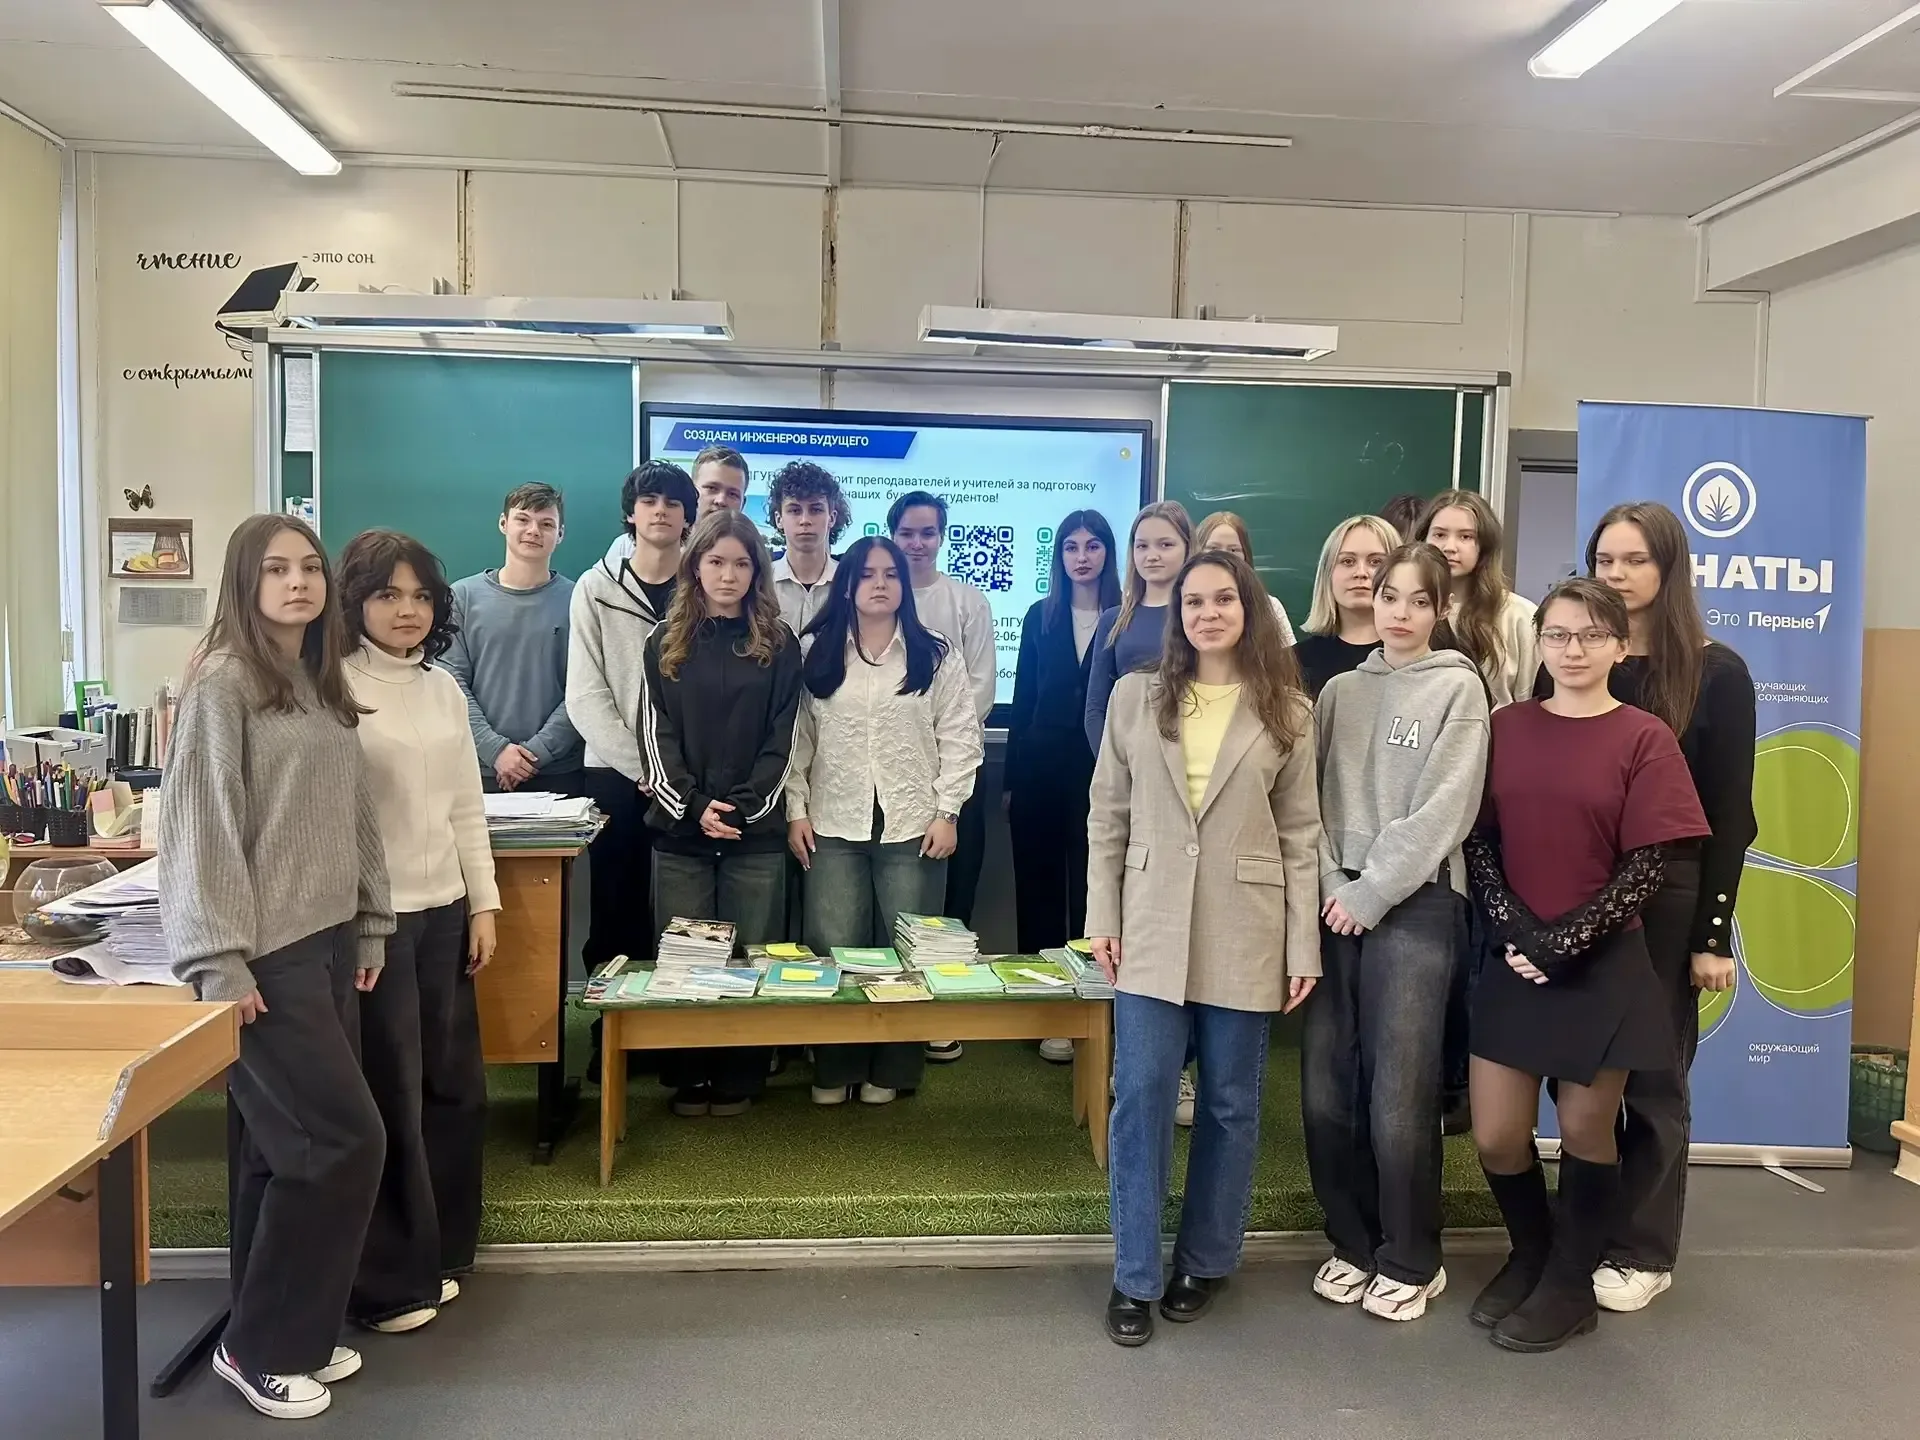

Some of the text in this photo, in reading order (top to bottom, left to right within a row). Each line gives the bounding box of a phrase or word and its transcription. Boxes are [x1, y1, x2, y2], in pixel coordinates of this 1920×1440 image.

[136, 252, 242, 270] чтение
[312, 252, 343, 264] это
[347, 253, 375, 264] сон
[123, 369, 136, 381] с
[683, 429, 869, 447] СОЗДАЕМ ИНЖЕНЕРОВ БУДУЩЕГО
[857, 475, 950, 488] преподавателей
[953, 479, 960, 488] и
[962, 478, 1014, 490] учителей
[1016, 481, 1030, 490] за
[1033, 480, 1096, 493] подготовку
[844, 490, 881, 500] наших
[1689, 553, 1834, 594] НАТЫ
[1706, 608, 1815, 632] Это Первые
[1753, 681, 1807, 693] зучающих
[1757, 693, 1829, 705] сохраняющих
[1387, 716, 1421, 750] LA
[1748, 1042, 1820, 1055] окружающий
[1748, 1055, 1771, 1065] мир
